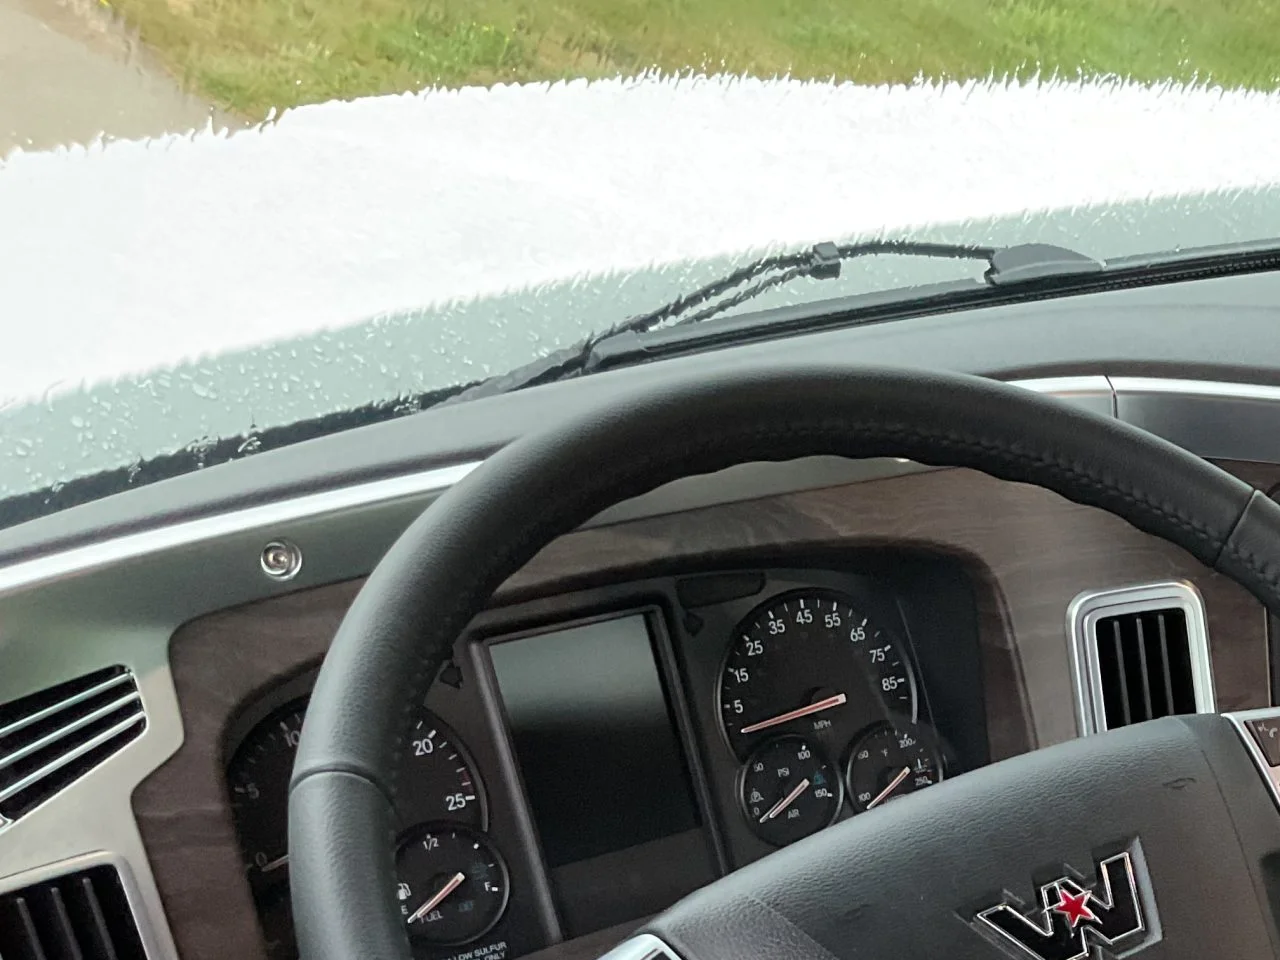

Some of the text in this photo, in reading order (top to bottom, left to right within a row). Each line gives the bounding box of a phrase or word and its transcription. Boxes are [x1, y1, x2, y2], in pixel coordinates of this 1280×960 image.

[796, 610, 813, 624] 45
[824, 613, 841, 628] 55
[768, 620, 785, 635] 35
[850, 628, 866, 642] 65
[746, 640, 764, 656] 25
[869, 649, 885, 663] 75
[734, 668, 749, 683] 15
[882, 677, 897, 691] 85
[734, 700, 744, 714] 5
[813, 719, 832, 731] MPH
[413, 739, 435, 756] 20
[798, 750, 811, 760] 100
[814, 788, 827, 798] 150
[446, 793, 467, 811] 25
[473, 941, 508, 957] SULFUR
